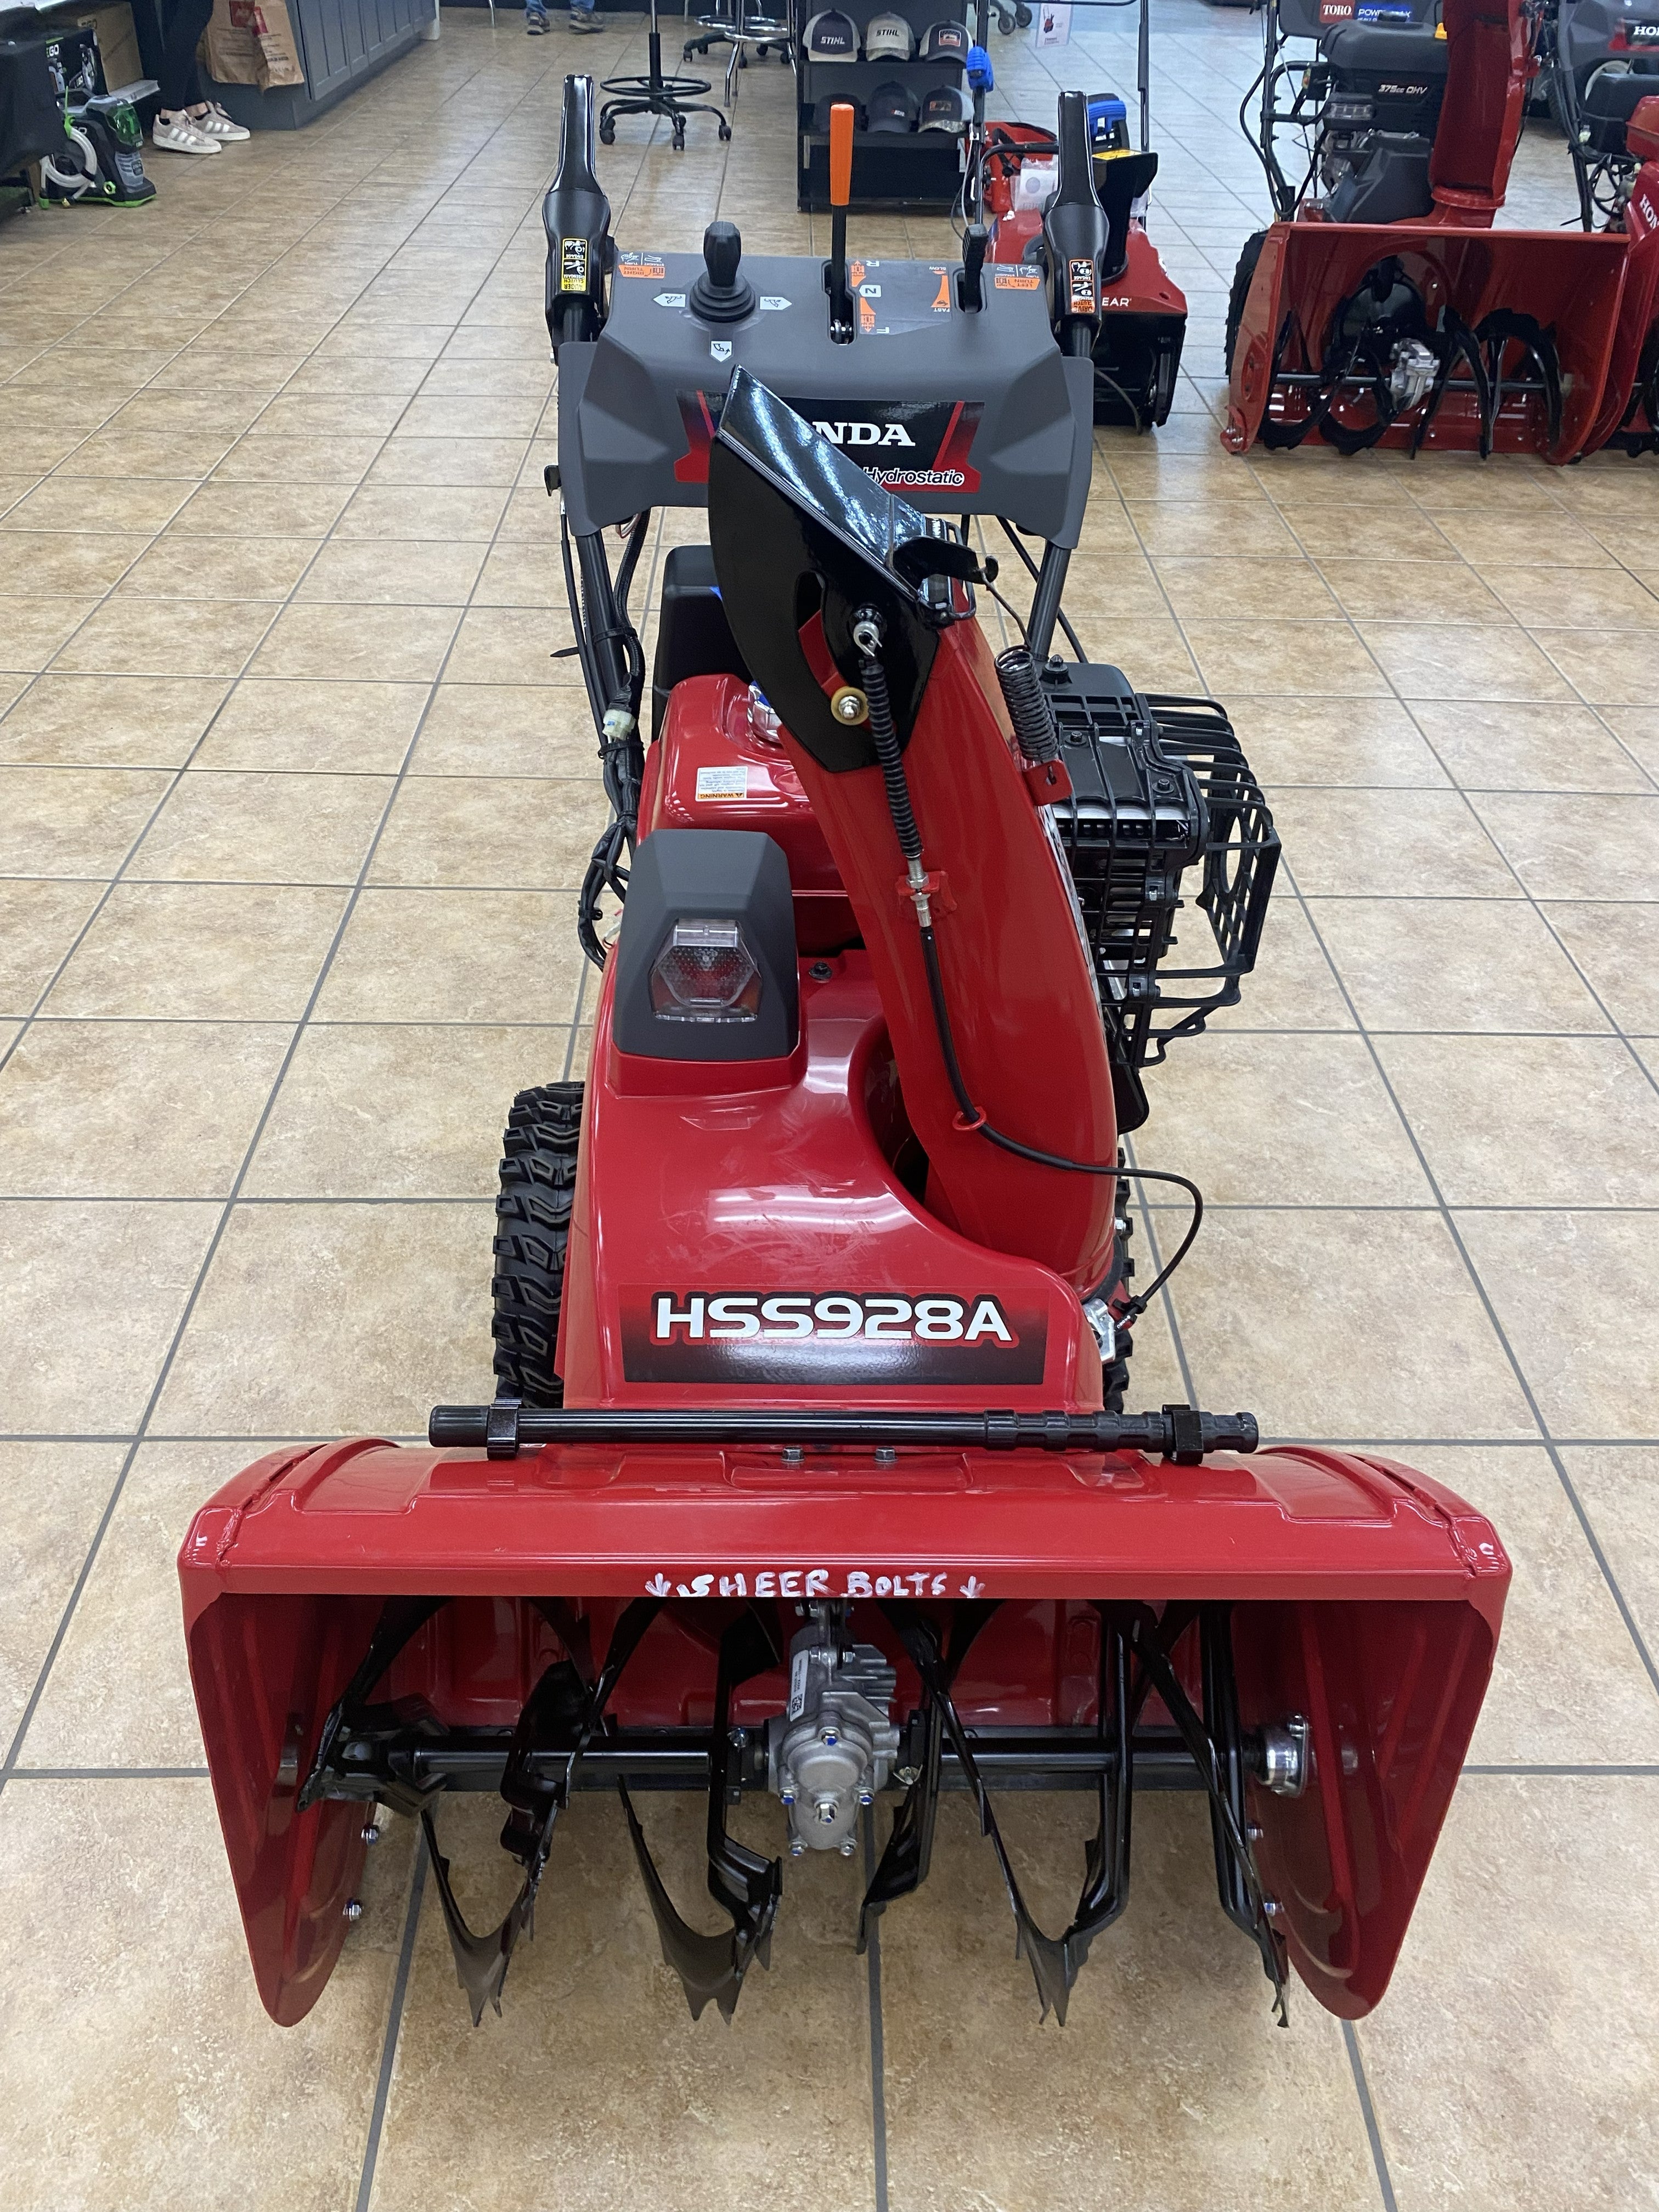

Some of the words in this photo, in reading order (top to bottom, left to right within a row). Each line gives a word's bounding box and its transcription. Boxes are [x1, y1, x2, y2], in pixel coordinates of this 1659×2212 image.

[1323, 4, 1352, 15] TORO
[1358, 8, 1386, 16] POW
[820, 36, 845, 45] STIHL
[1378, 84, 1405, 93] 375cc
[1406, 86, 1427, 94] OHV
[1639, 193, 1659, 229] HON
[1102, 297, 1128, 307] EAR
[812, 421, 916, 446] NDA
[863, 467, 965, 487] Hydrostatic
[657, 1297, 1013, 1341] HSS928A
[676, 1570, 834, 1598] SHEER
[840, 1571, 947, 1598] BOLTS
